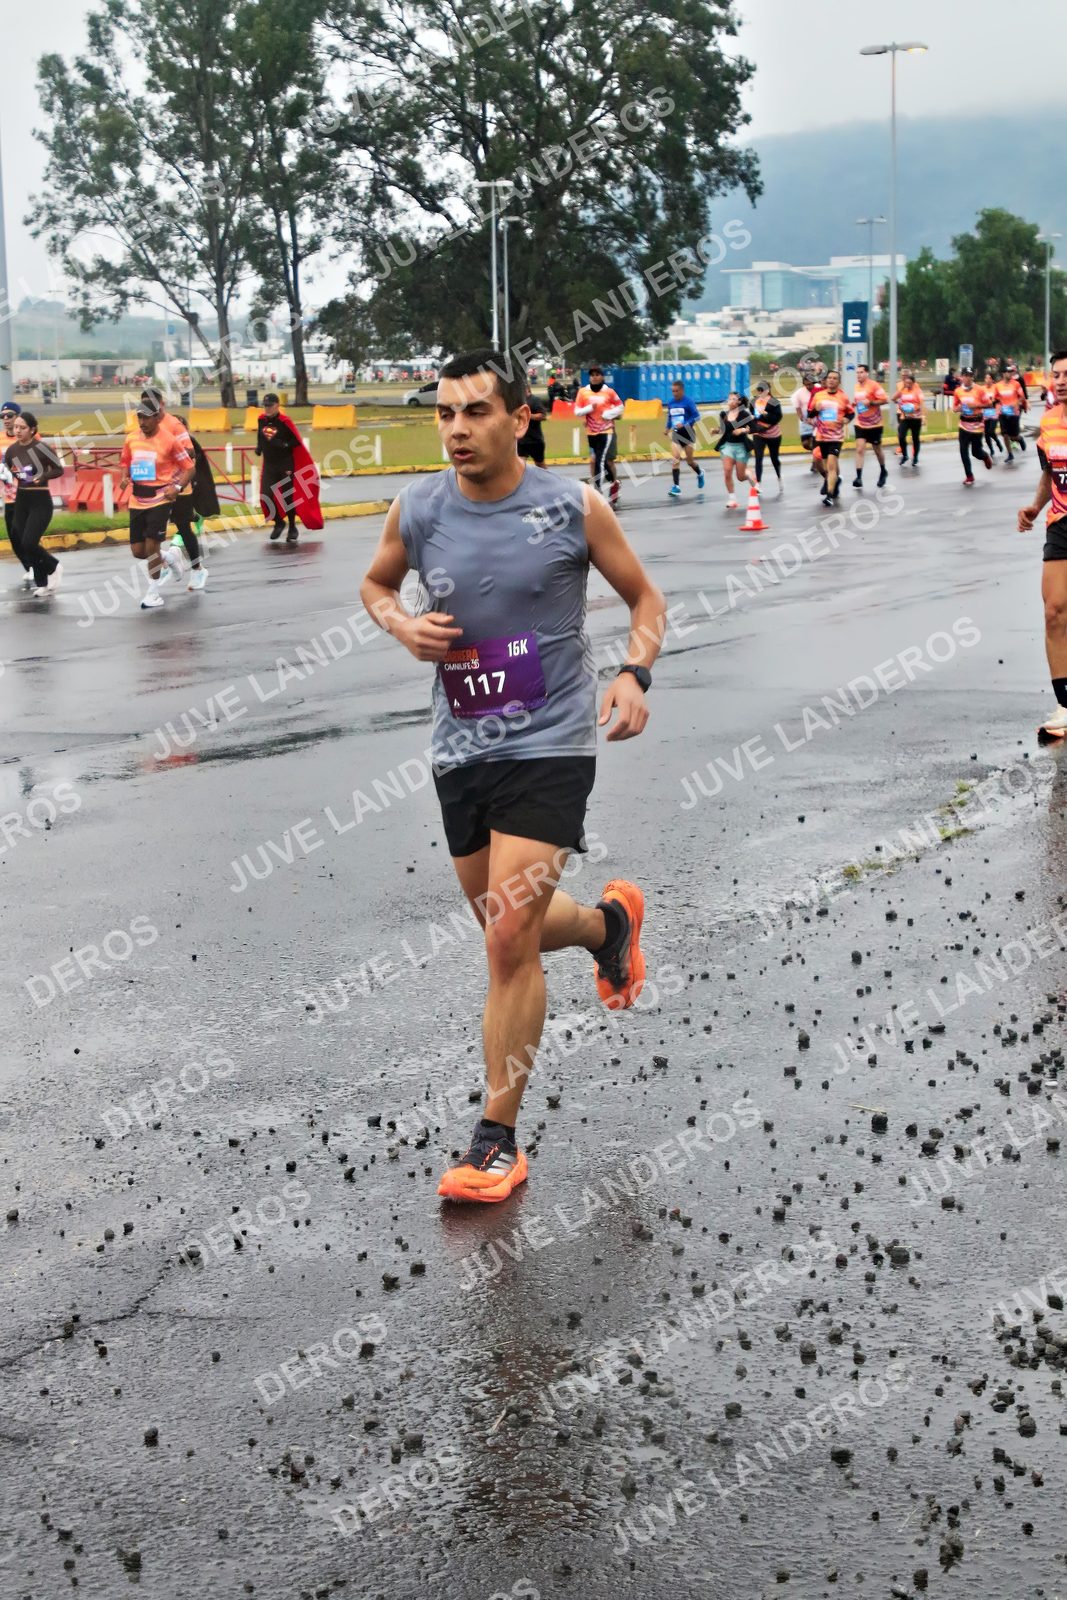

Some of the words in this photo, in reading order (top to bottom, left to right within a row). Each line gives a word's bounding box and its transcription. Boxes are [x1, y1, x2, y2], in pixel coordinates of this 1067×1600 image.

[847, 318, 861, 338] E
[507, 638, 528, 657] 16K
[463, 671, 506, 696] 117
